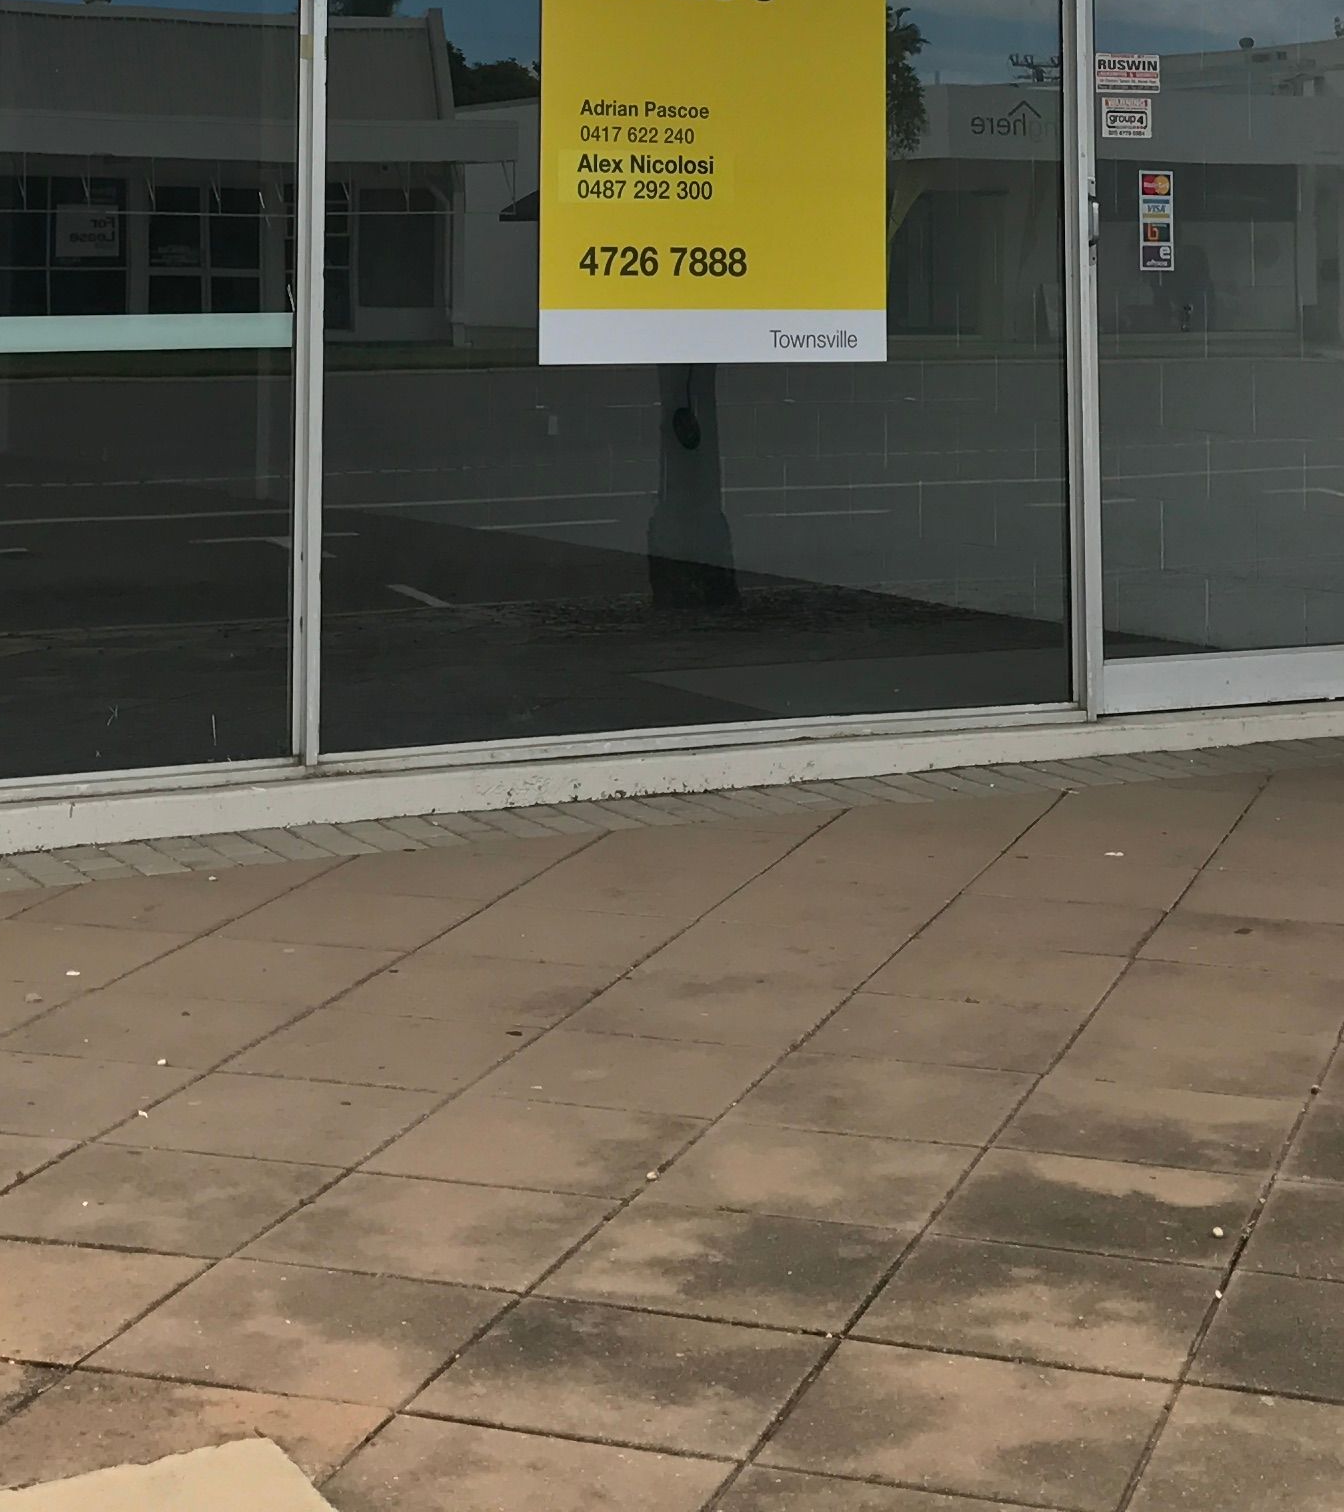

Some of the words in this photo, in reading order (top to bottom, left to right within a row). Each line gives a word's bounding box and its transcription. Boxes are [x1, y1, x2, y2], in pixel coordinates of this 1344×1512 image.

[1097, 58, 1158, 71] RUSWIN
[579, 99, 640, 119] Adrian
[644, 102, 711, 120] Pascoe
[580, 125, 622, 144] 0417
[627, 126, 659, 144] 622
[663, 127, 695, 145] 240
[577, 153, 624, 174] Alex
[629, 154, 715, 176] Nicolosi
[577, 180, 627, 200] 0487
[633, 180, 670, 200] 292
[676, 180, 713, 201] 300
[578, 246, 659, 277] 4726
[670, 246, 748, 278] 7888
[769, 329, 859, 350] Townsville
